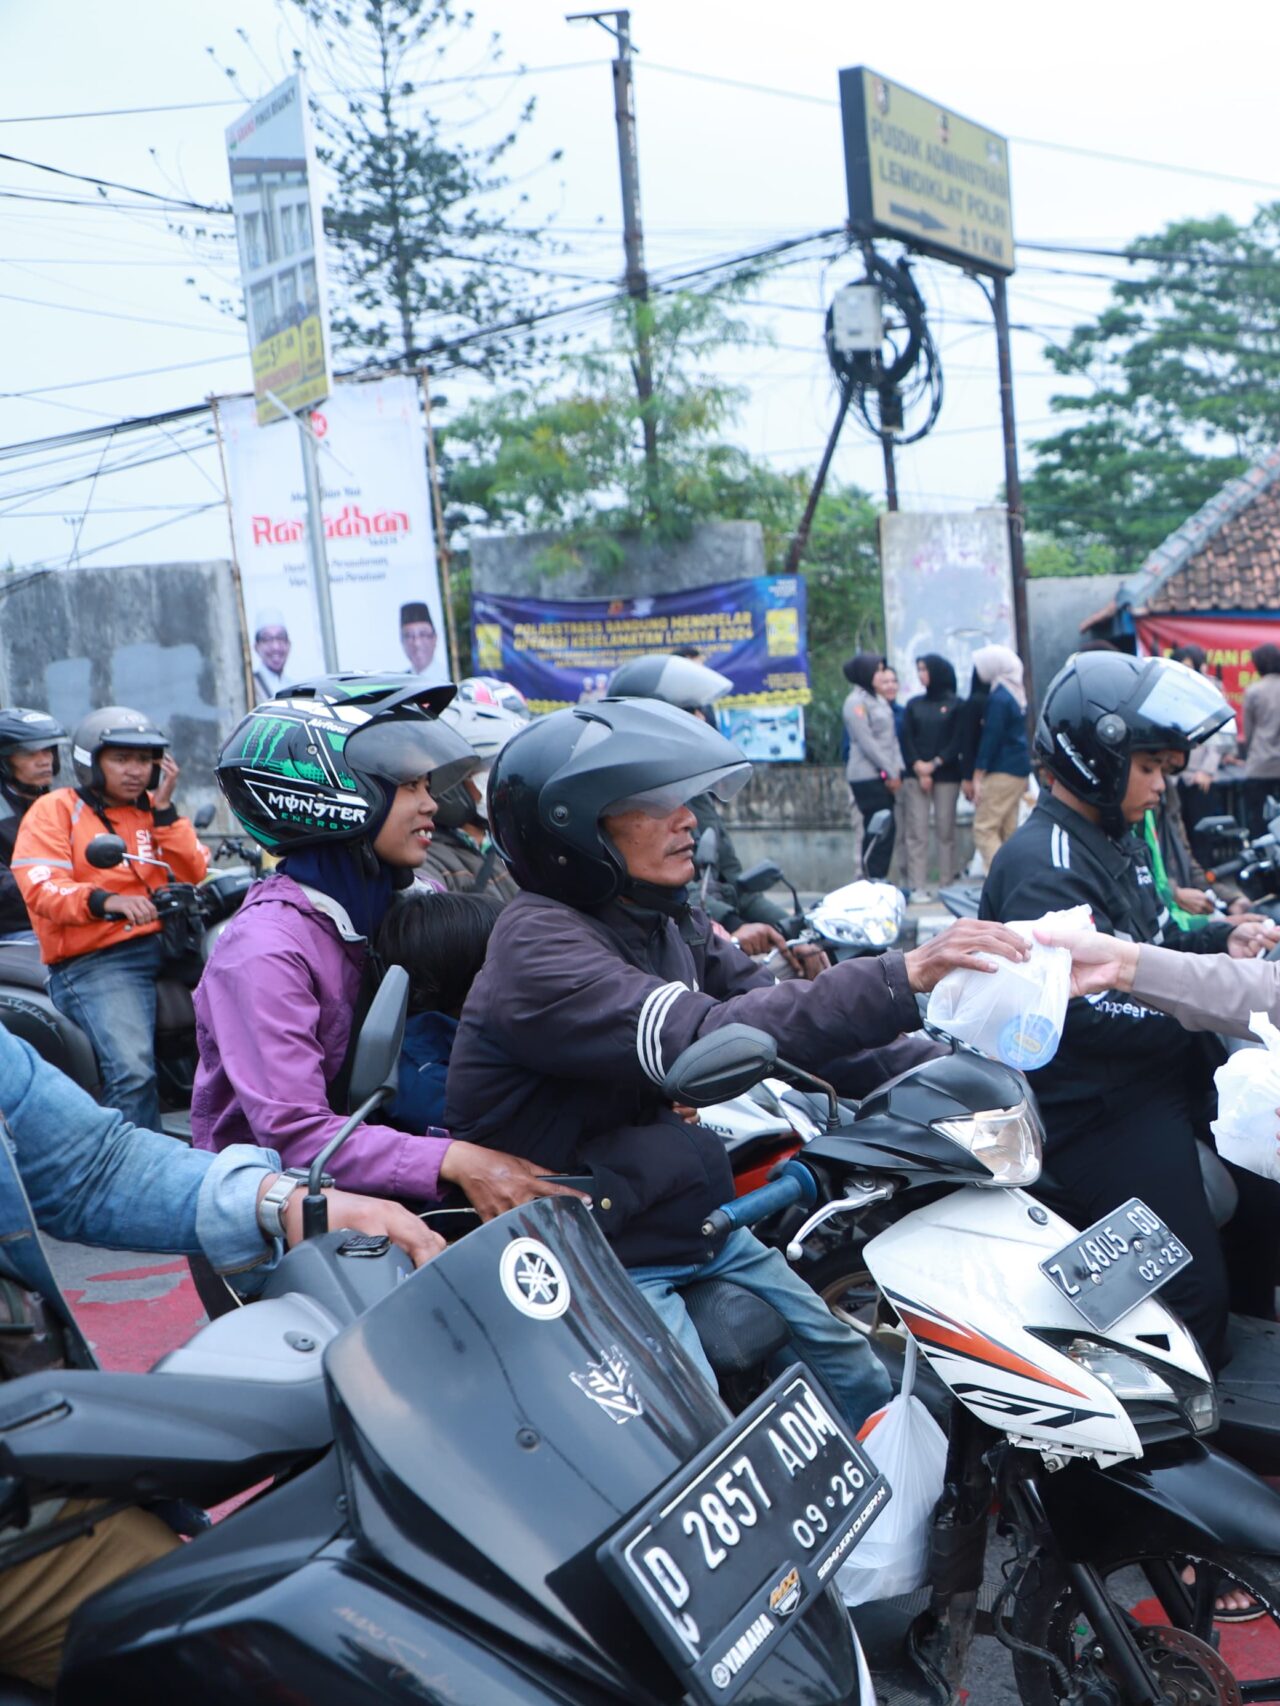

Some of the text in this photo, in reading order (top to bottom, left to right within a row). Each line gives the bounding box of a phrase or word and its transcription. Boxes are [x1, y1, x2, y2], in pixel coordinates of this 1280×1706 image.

[877, 155, 964, 211] LEMDIKLAT
[308, 718, 349, 734] Airflow
[281, 812, 351, 830] ENERGY
[1049, 1263, 1081, 1296] Z
[1078, 1226, 1129, 1273] 4805
[643, 1390, 838, 1609] D 2857 ADM
[721, 1612, 775, 1675] YAMAHA
